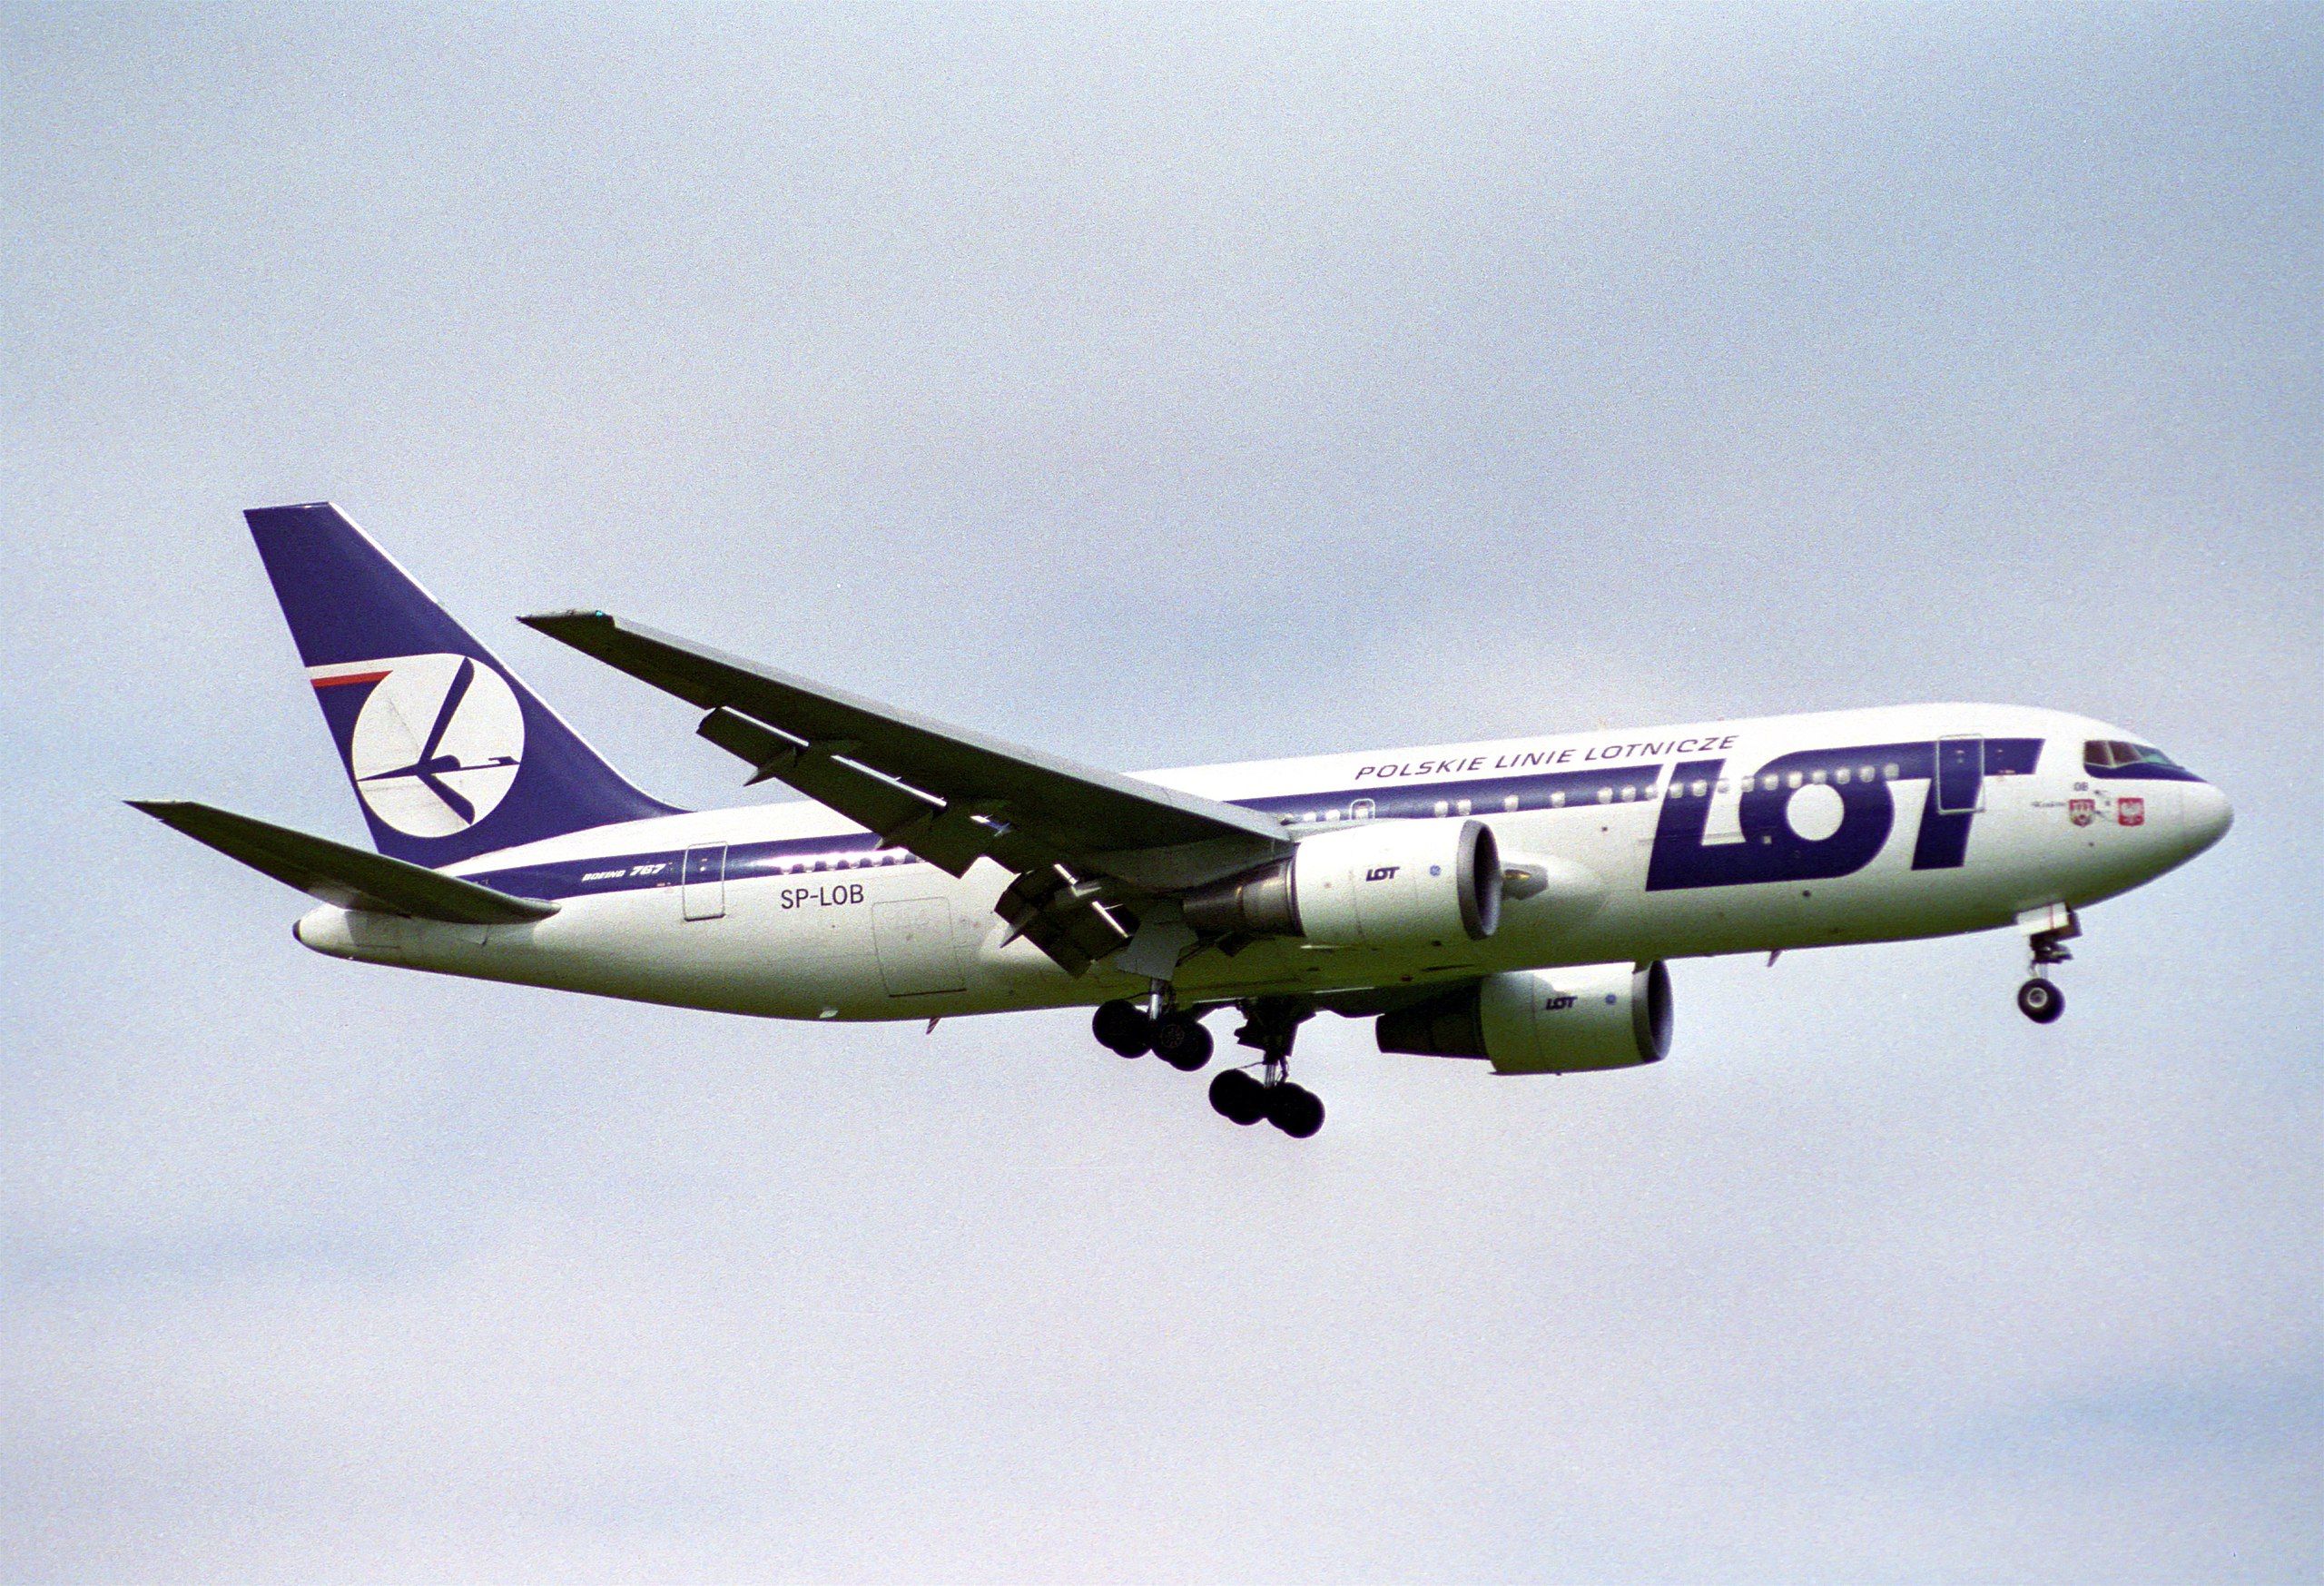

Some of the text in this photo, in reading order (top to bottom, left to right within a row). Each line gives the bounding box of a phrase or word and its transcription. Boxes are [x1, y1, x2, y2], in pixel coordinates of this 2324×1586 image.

[1354, 735, 1739, 780] POLSKIE LINIE LOTNICZE
[1645, 738, 2046, 892] LOT
[581, 863, 667, 882] BOEING 767
[1365, 866, 1401, 882] LOT
[781, 883, 864, 909] SP-LOB
[1546, 995, 1578, 1010] LOT
